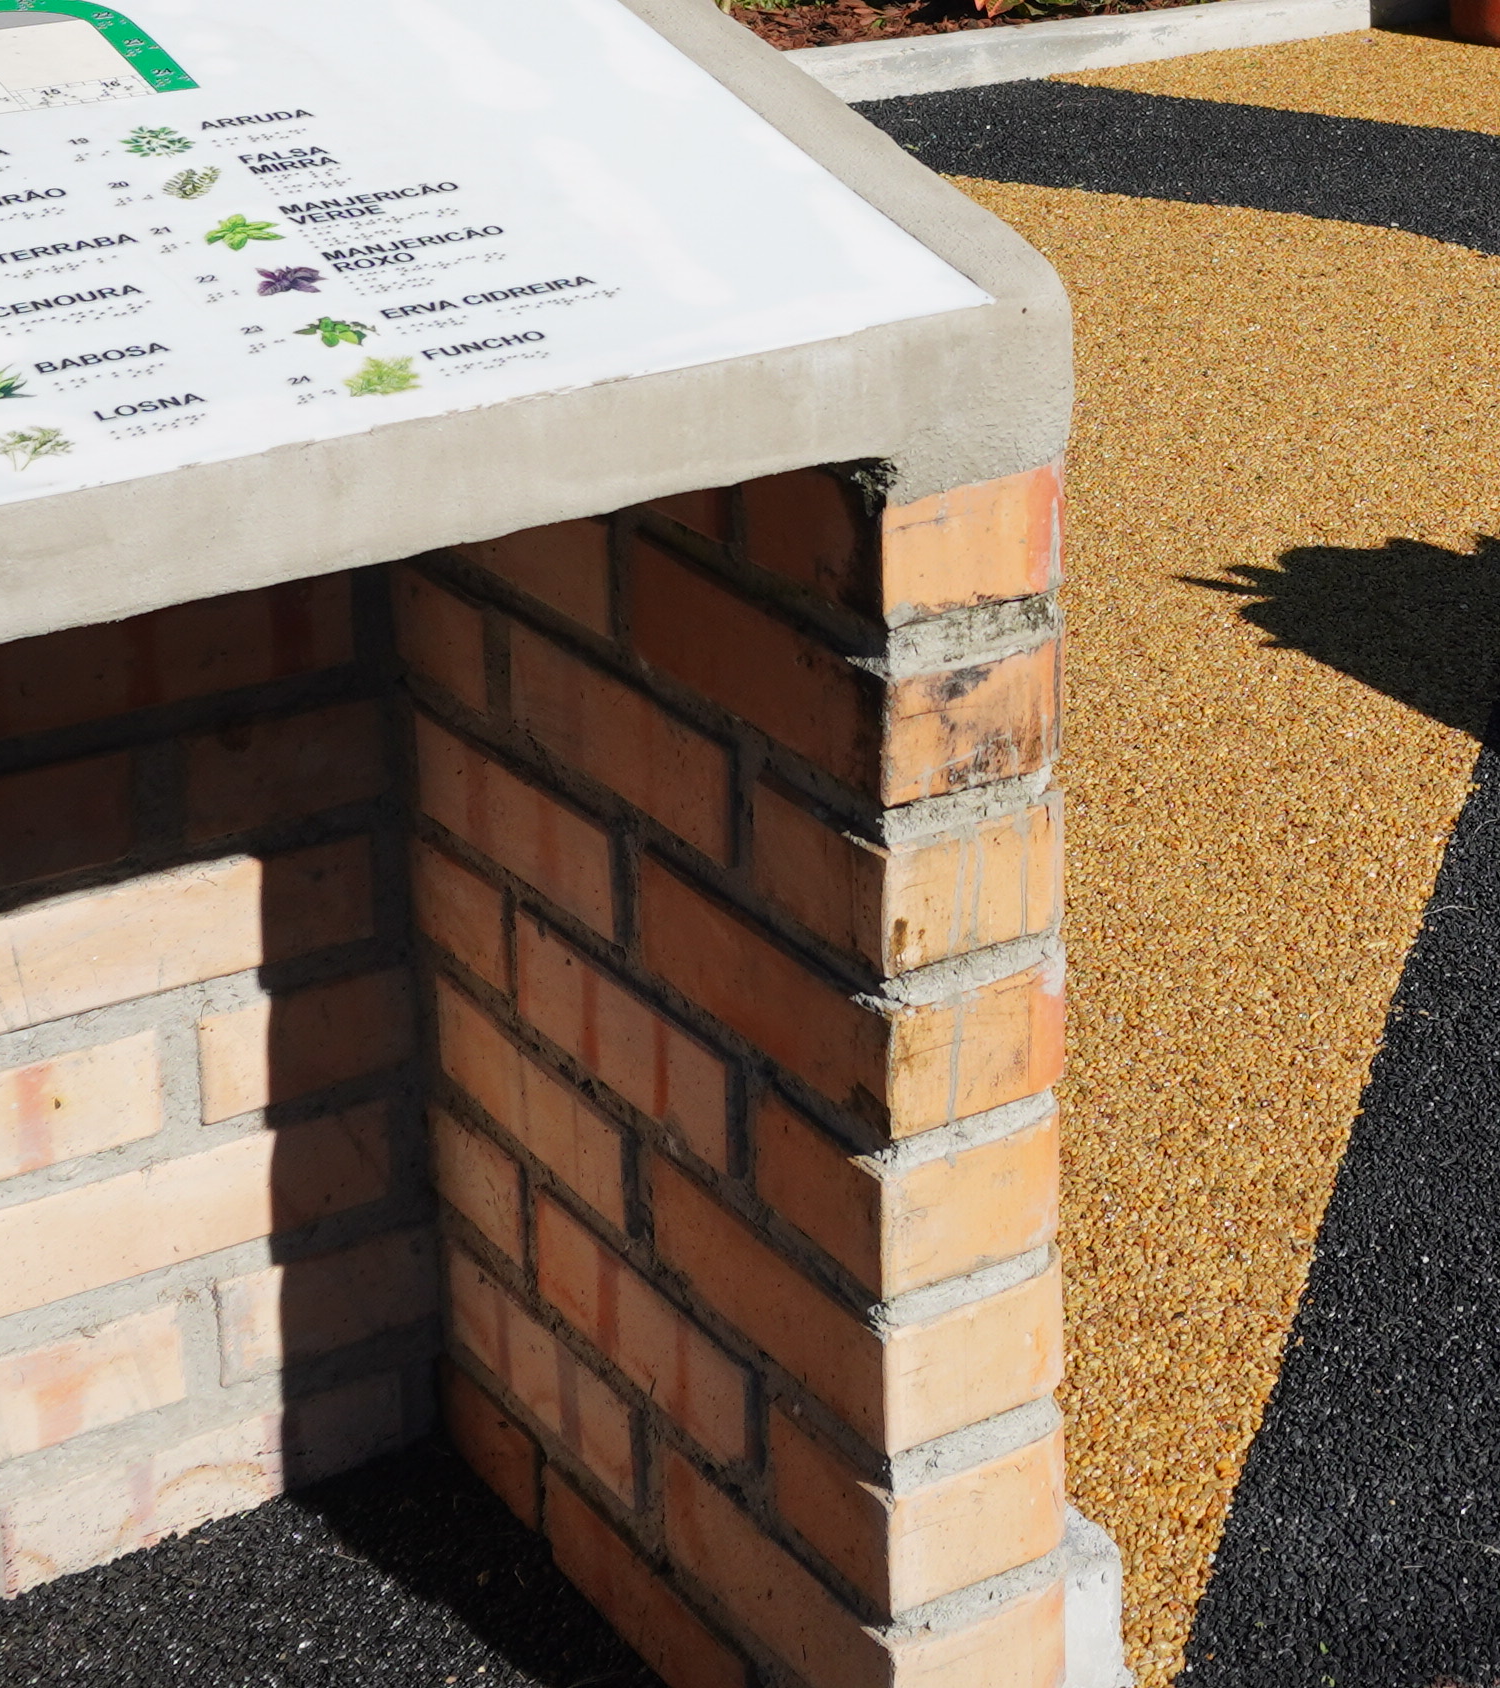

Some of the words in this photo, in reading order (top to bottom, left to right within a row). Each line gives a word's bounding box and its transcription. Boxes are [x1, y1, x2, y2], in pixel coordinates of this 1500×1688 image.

[200, 108, 315, 131] ARRUDA
[67, 137, 90, 145] 19
[238, 145, 330, 166] FALSA
[248, 156, 340, 176] MIRRA
[107, 180, 130, 189] 20
[278, 181, 460, 216] MANJERICÃO
[287, 204, 386, 226] VERDE
[150, 226, 172, 235] 21
[321, 225, 505, 263] MANJERICÃO
[333, 252, 416, 274] ROXO
[195, 274, 219, 284] 22
[379, 297, 460, 321] ERVA
[461, 275, 596, 306] CIDREIRA
[240, 325, 263, 335] 23
[421, 330, 546, 361] FUNCHO
[33, 342, 171, 375] BABOSA
[287, 375, 311, 385] 24
[93, 392, 209, 422] LOSNA
